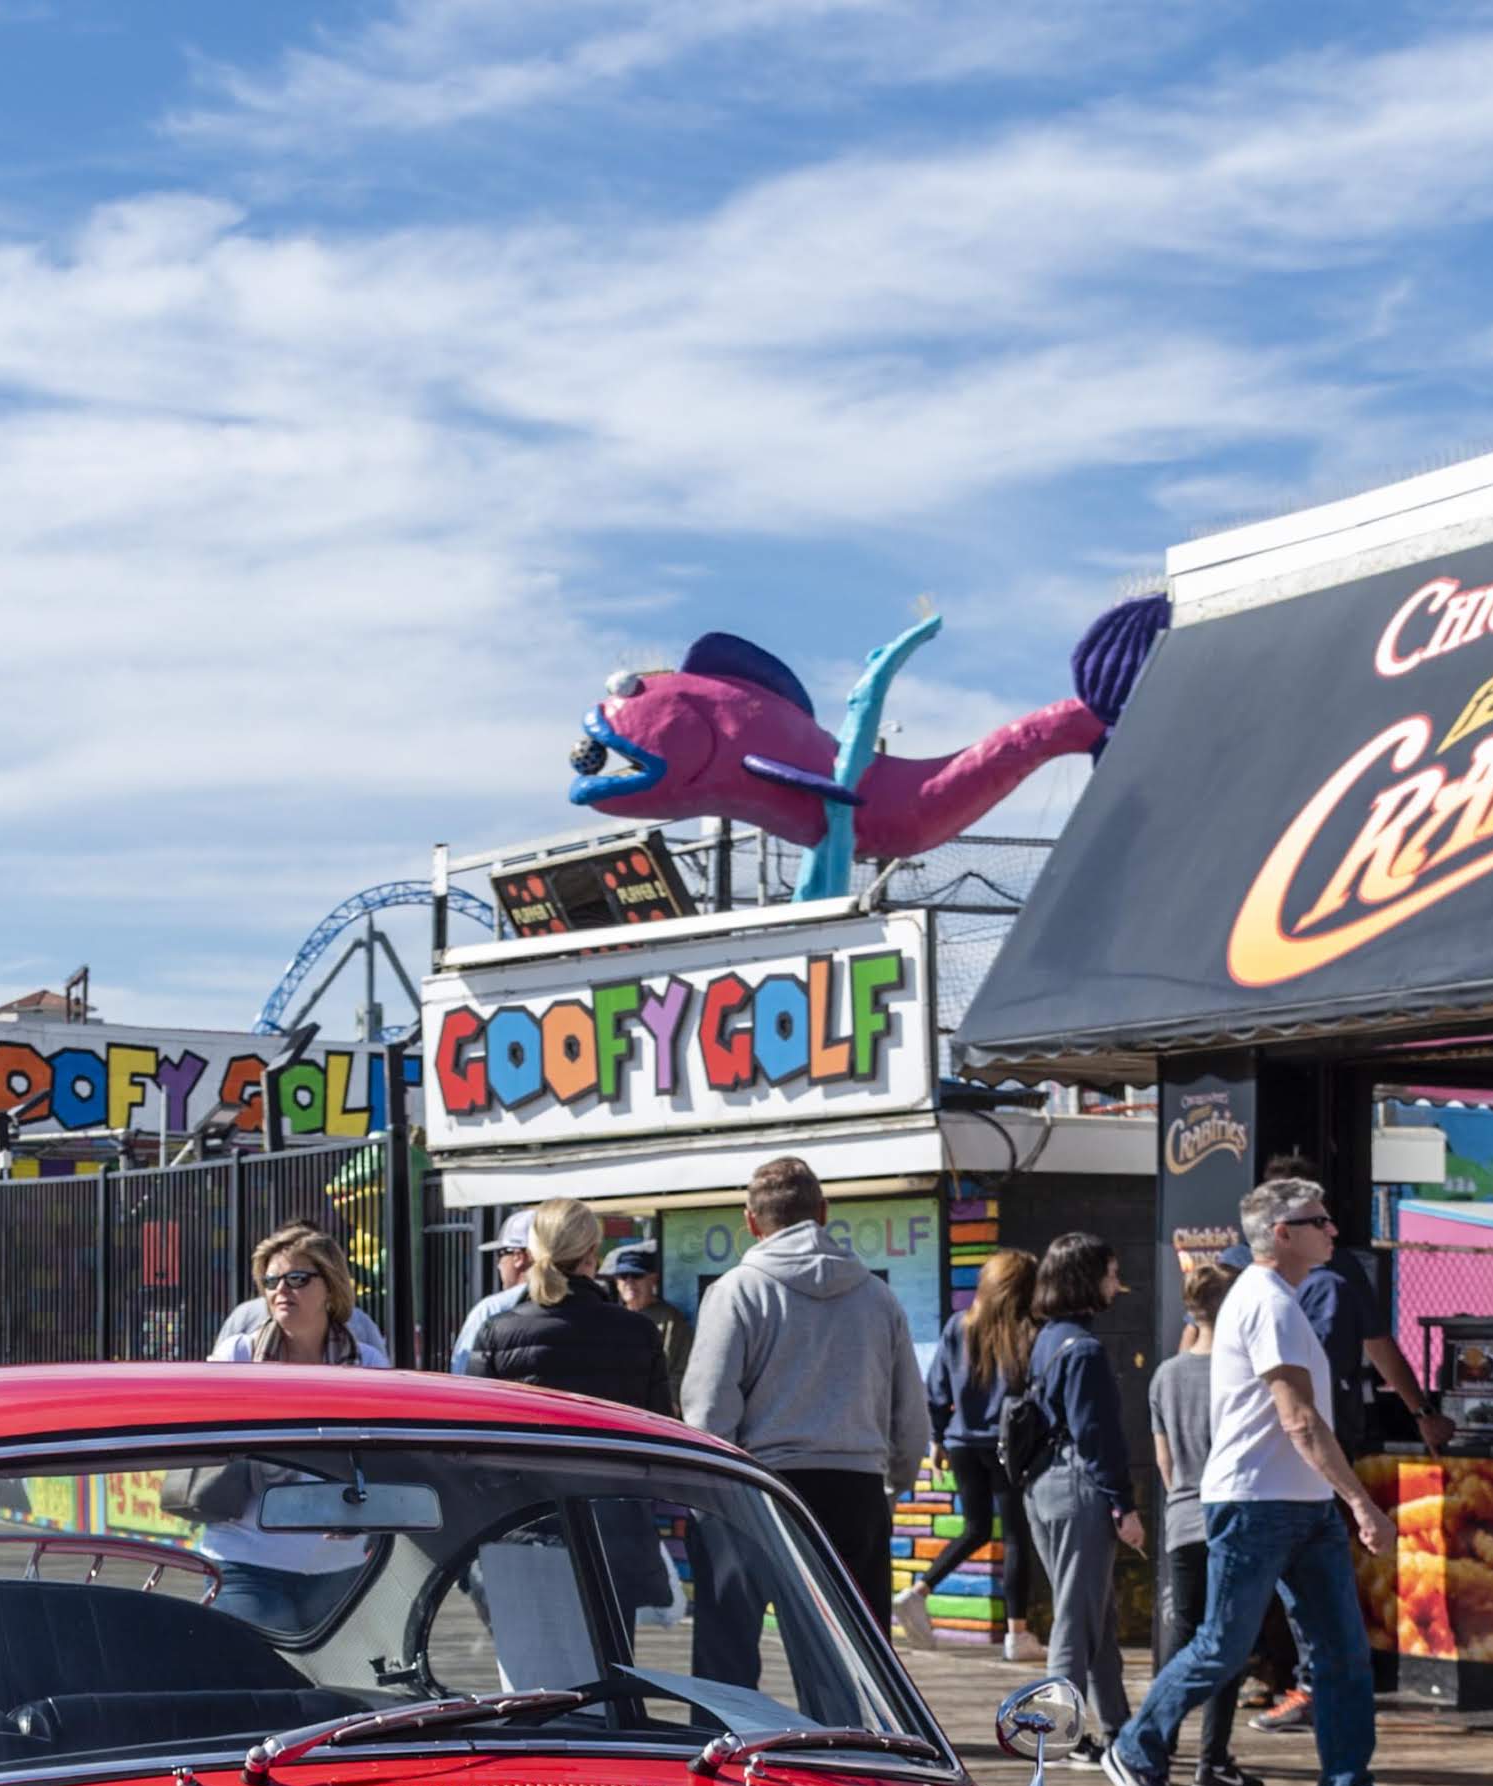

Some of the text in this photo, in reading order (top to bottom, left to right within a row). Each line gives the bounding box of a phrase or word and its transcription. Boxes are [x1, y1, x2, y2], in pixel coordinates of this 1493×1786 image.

[616, 883, 657, 905] PLAYER
[434, 950, 902, 1115] GOOFY GOLF
[219, 1050, 422, 1138] GOLF
